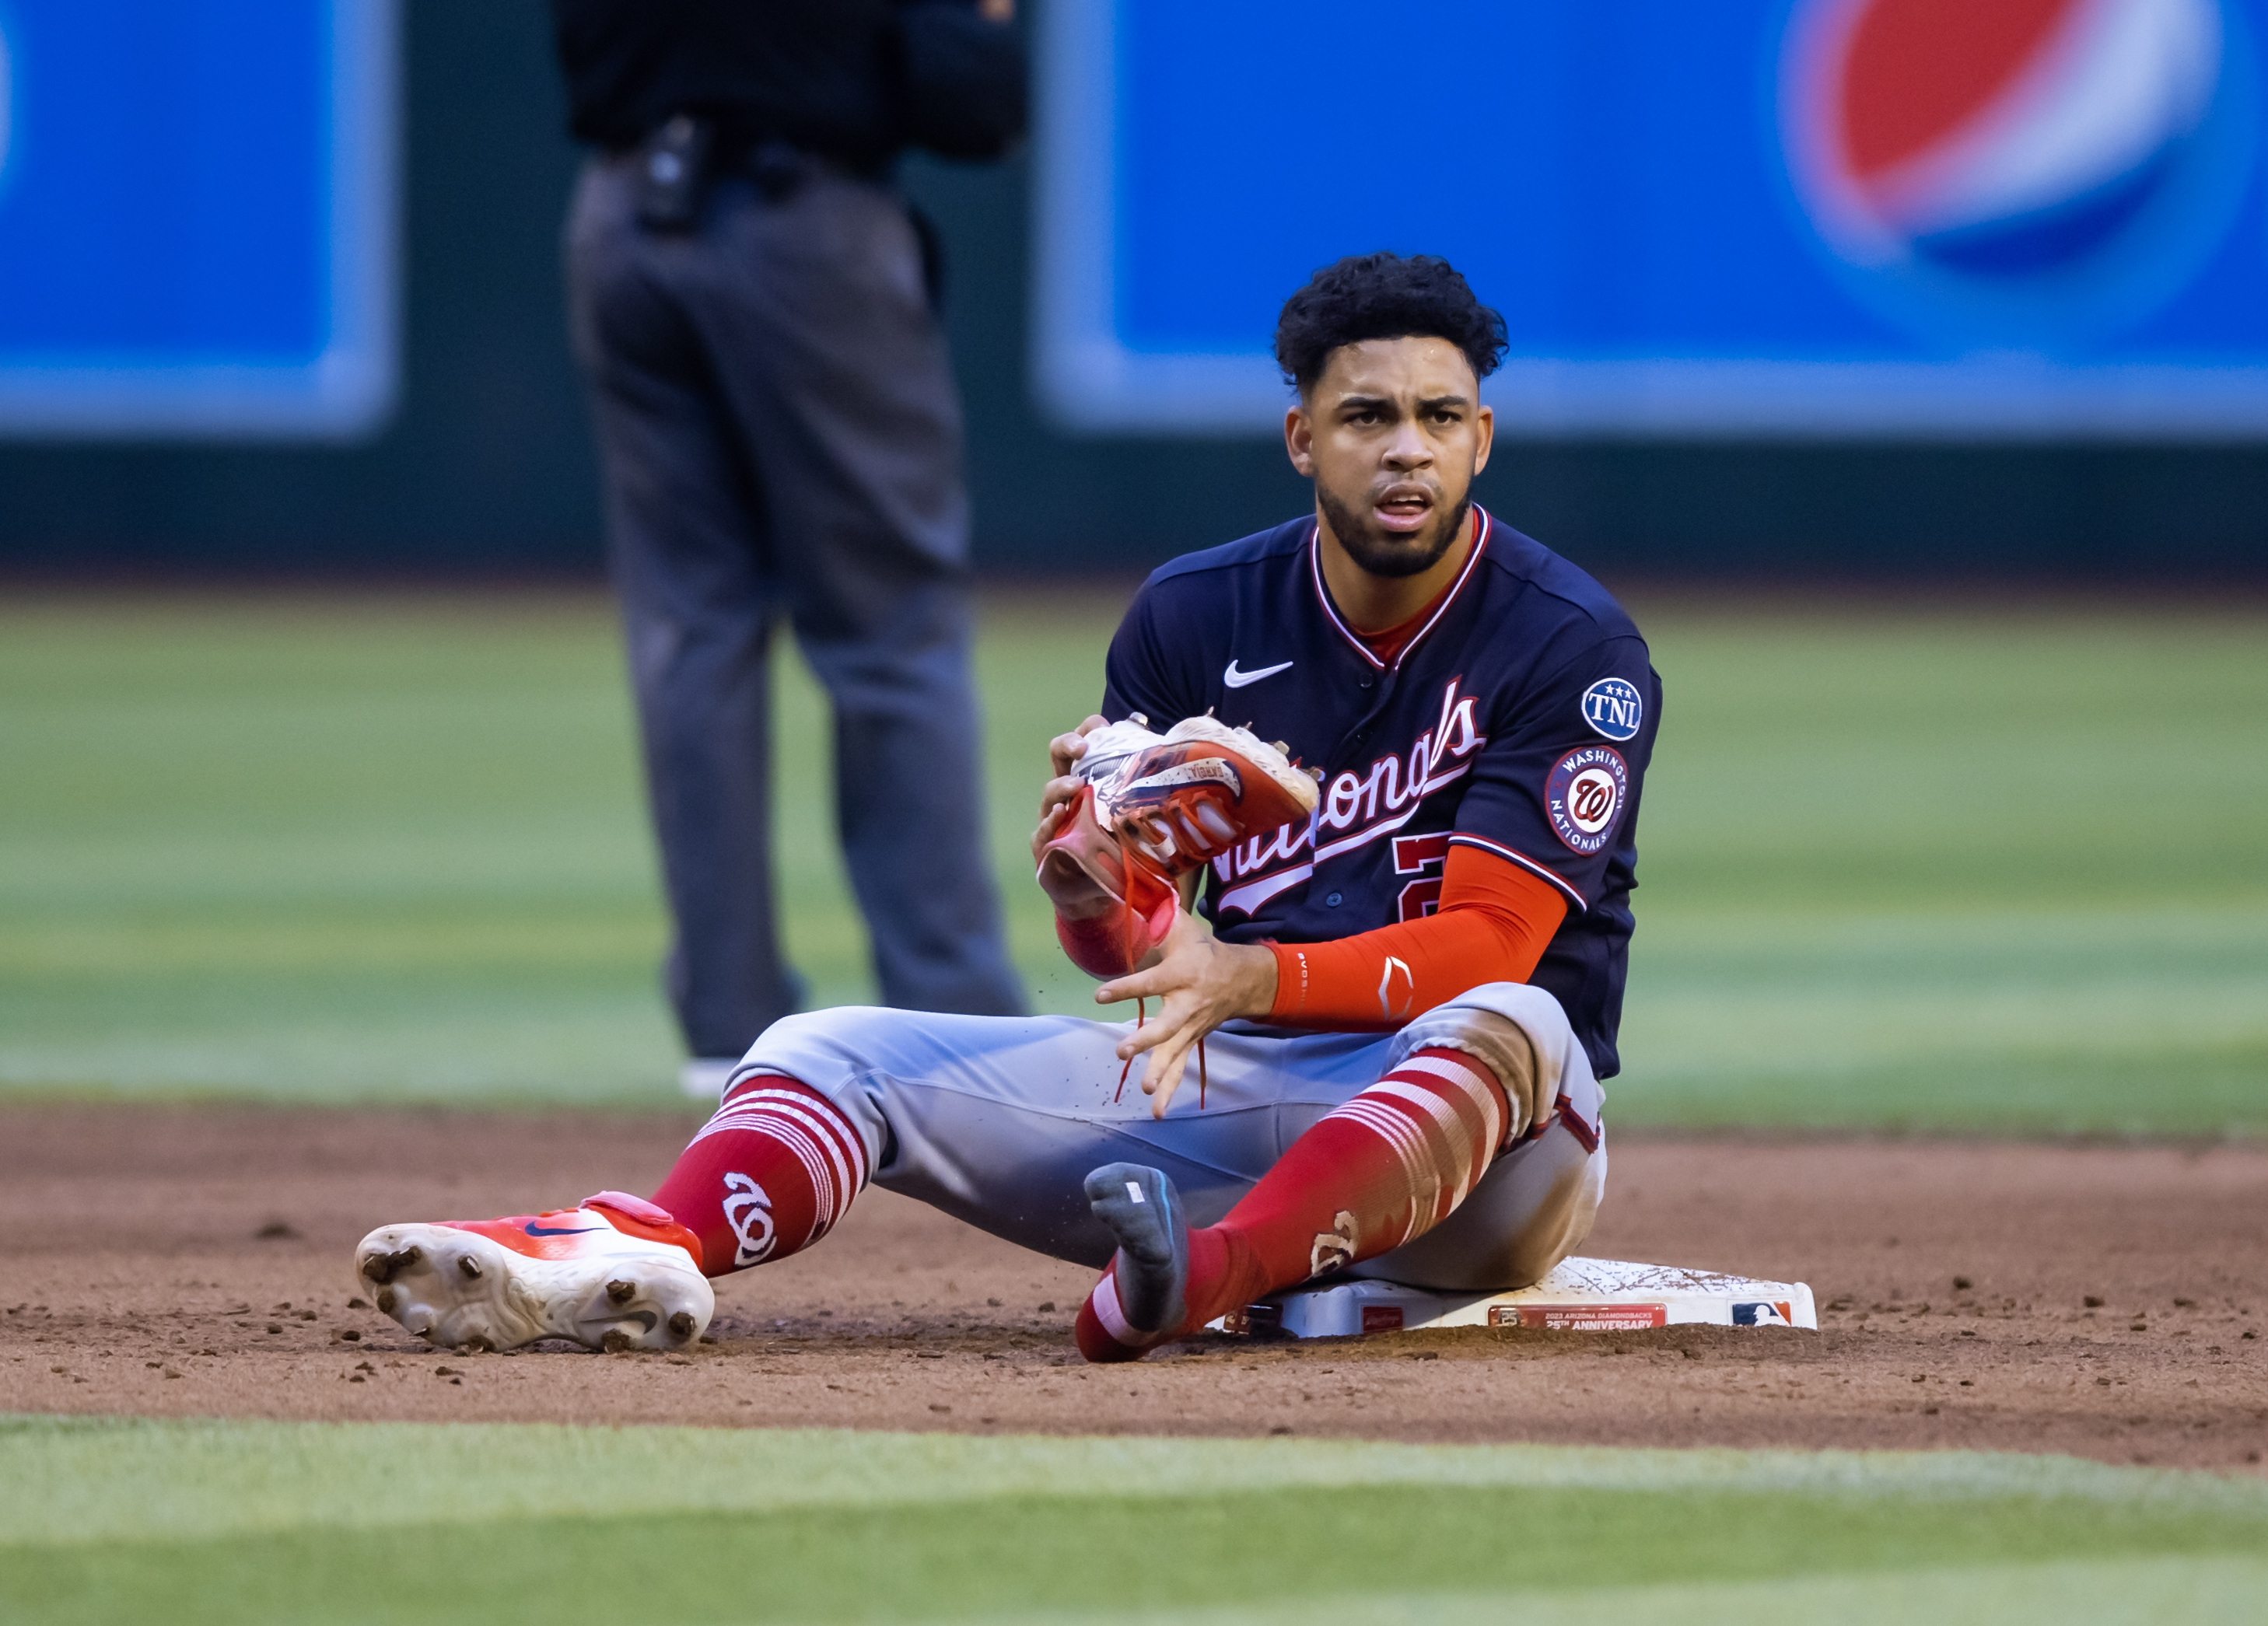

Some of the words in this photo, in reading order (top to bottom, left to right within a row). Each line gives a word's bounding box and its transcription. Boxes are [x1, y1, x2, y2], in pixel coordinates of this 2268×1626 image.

[1588, 692, 1639, 729] TNL
[1563, 750, 1626, 810] WASHINGTON
[1551, 799, 1607, 851] NATIONALS
[1572, 1320, 1652, 1331] ANNIVERSARY
